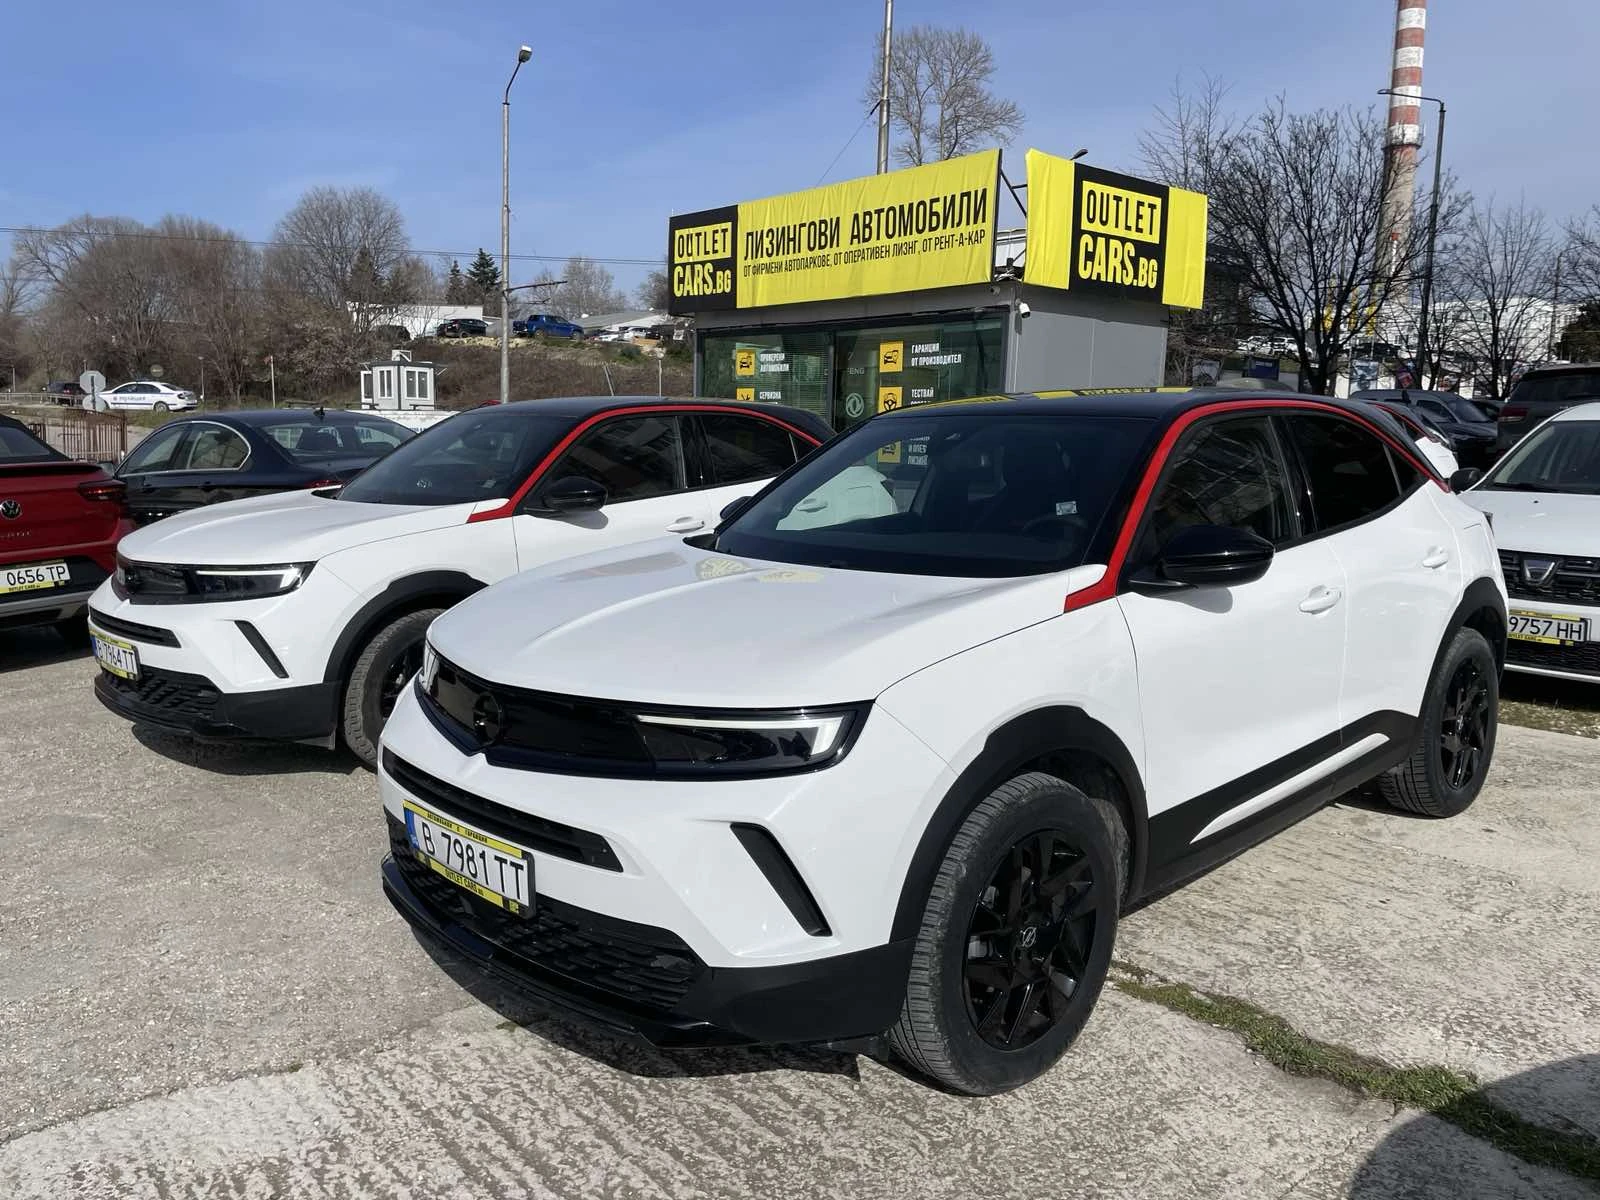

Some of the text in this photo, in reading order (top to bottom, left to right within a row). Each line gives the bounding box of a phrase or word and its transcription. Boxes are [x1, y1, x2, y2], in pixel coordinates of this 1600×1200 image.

[744, 188, 987, 261] ЛИЗИНГОВИ АВТОМОБИЛИ
[1086, 189, 1157, 236] OUTLET
[677, 228, 729, 258] OUTLET
[743, 264, 752, 277] ОТ
[752, 261, 783, 276] ФИРМЕНИ
[833, 253, 843, 265] ОТ
[844, 246, 890, 264] ОПЕРАТИВЕН
[922, 237, 934, 252] ОТ
[934, 229, 986, 250] РЕНТ-А-КАР
[1078, 233, 1158, 289] CARS.BG
[673, 262, 731, 297] CARS.BG
[911, 354, 962, 367] ОТ ПРОИЗВОДИТЕЛ
[911, 387, 934, 398] ТЕСТВАЙ
[6, 565, 66, 586] 0656 TP
[1509, 616, 1553, 636] 9757
[1556, 622, 1582, 640] HH
[122, 649, 135, 672] TT
[421, 821, 524, 900] B 7981 TT
